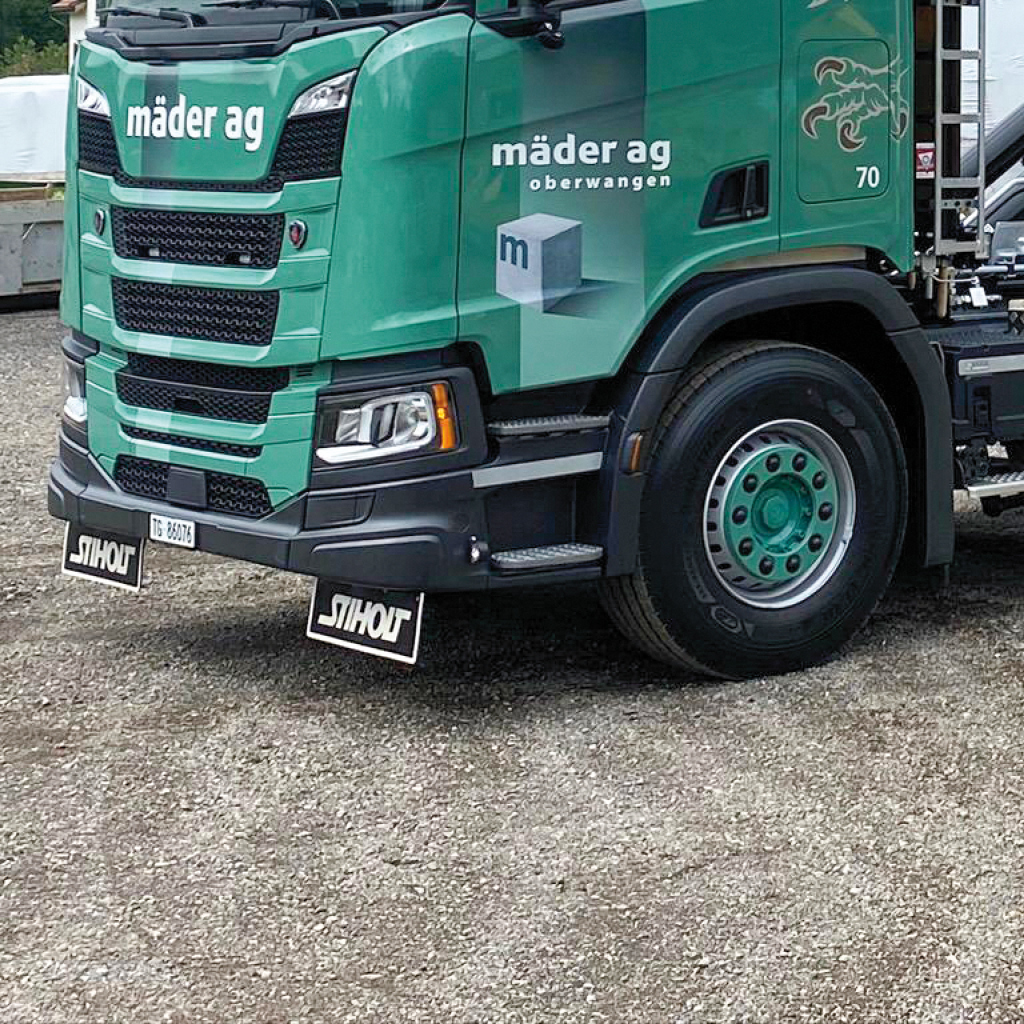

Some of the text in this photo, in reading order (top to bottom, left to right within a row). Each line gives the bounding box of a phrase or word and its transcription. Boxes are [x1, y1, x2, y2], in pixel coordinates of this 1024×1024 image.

[127, 93, 265, 152] mäder ag
[492, 133, 671, 171] mäder ag
[529, 175, 671, 191] oberwangen
[855, 166, 880, 189] 70
[500, 233, 529, 270] m
[152, 517, 163, 537] TG
